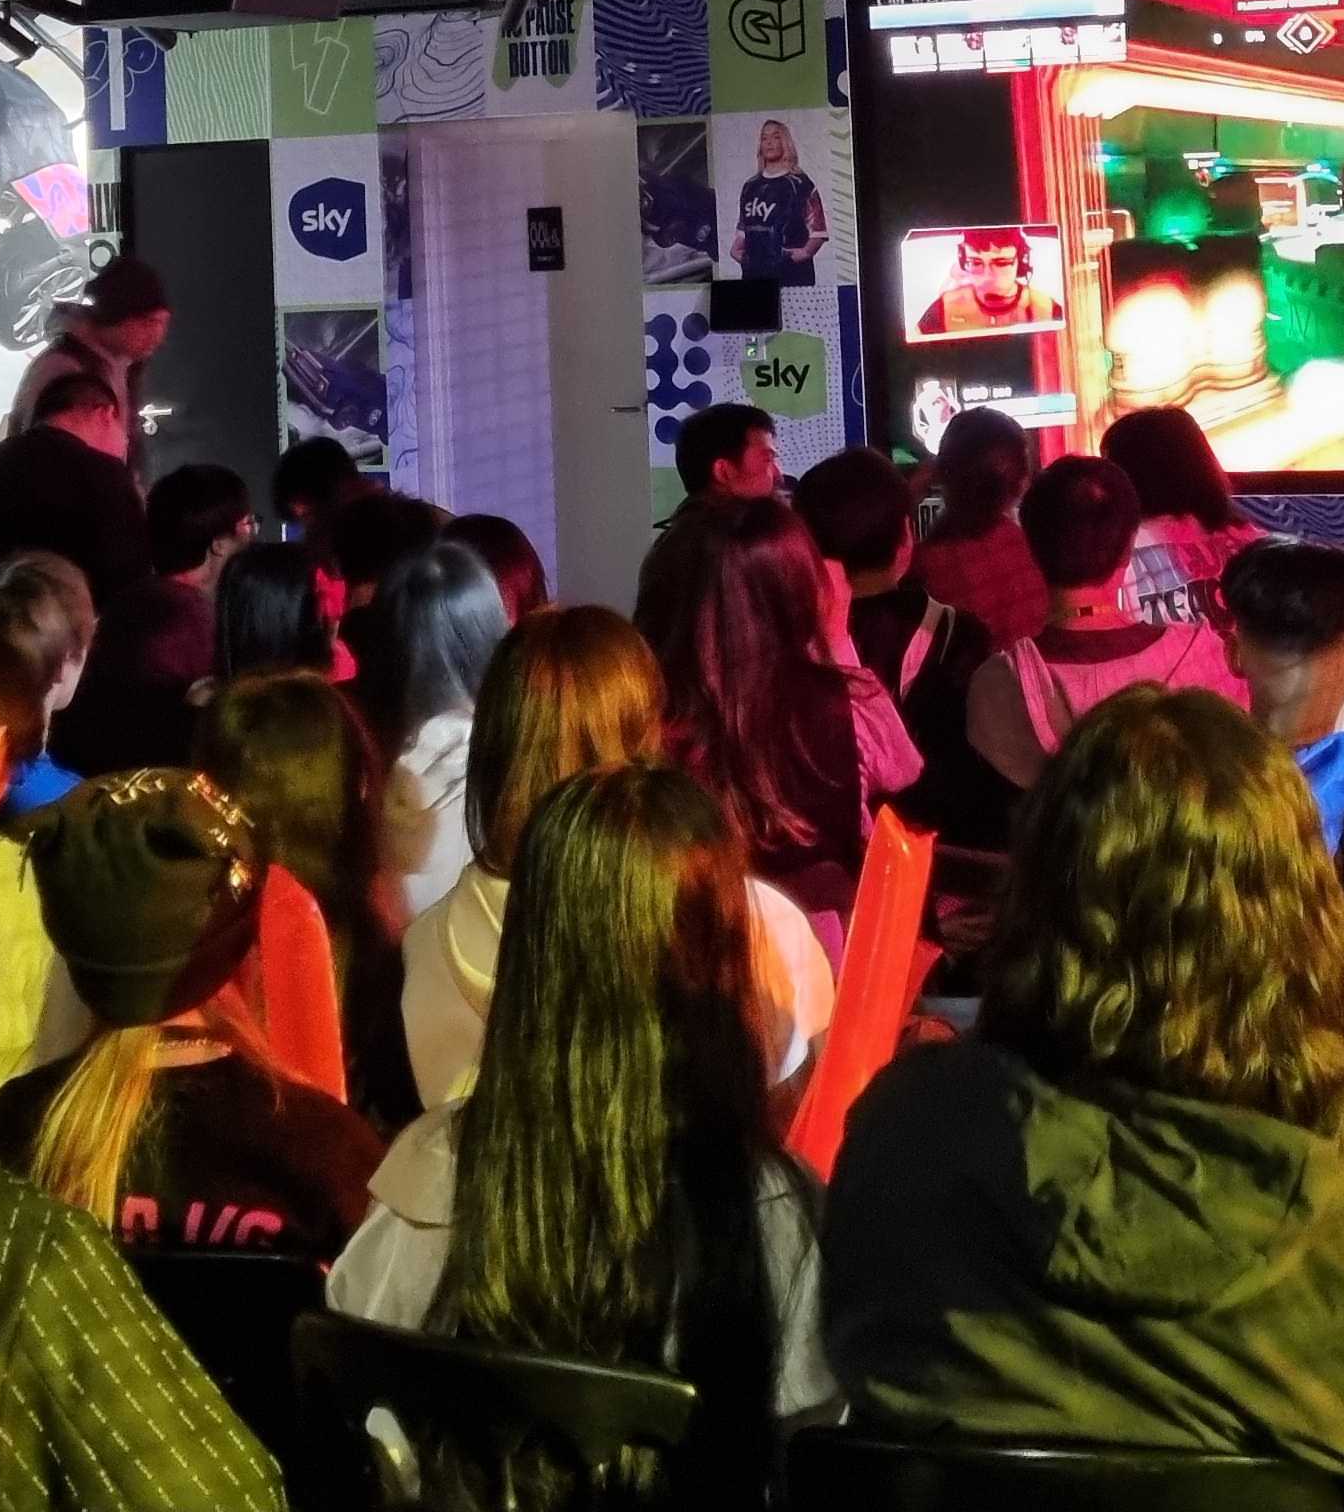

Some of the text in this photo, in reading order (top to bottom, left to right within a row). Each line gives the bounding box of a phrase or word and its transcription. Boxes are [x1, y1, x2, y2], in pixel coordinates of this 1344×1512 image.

[508, 39, 571, 78] BUTTON
[301, 202, 353, 238] sky
[744, 197, 777, 223] sky
[754, 357, 810, 394] sky
